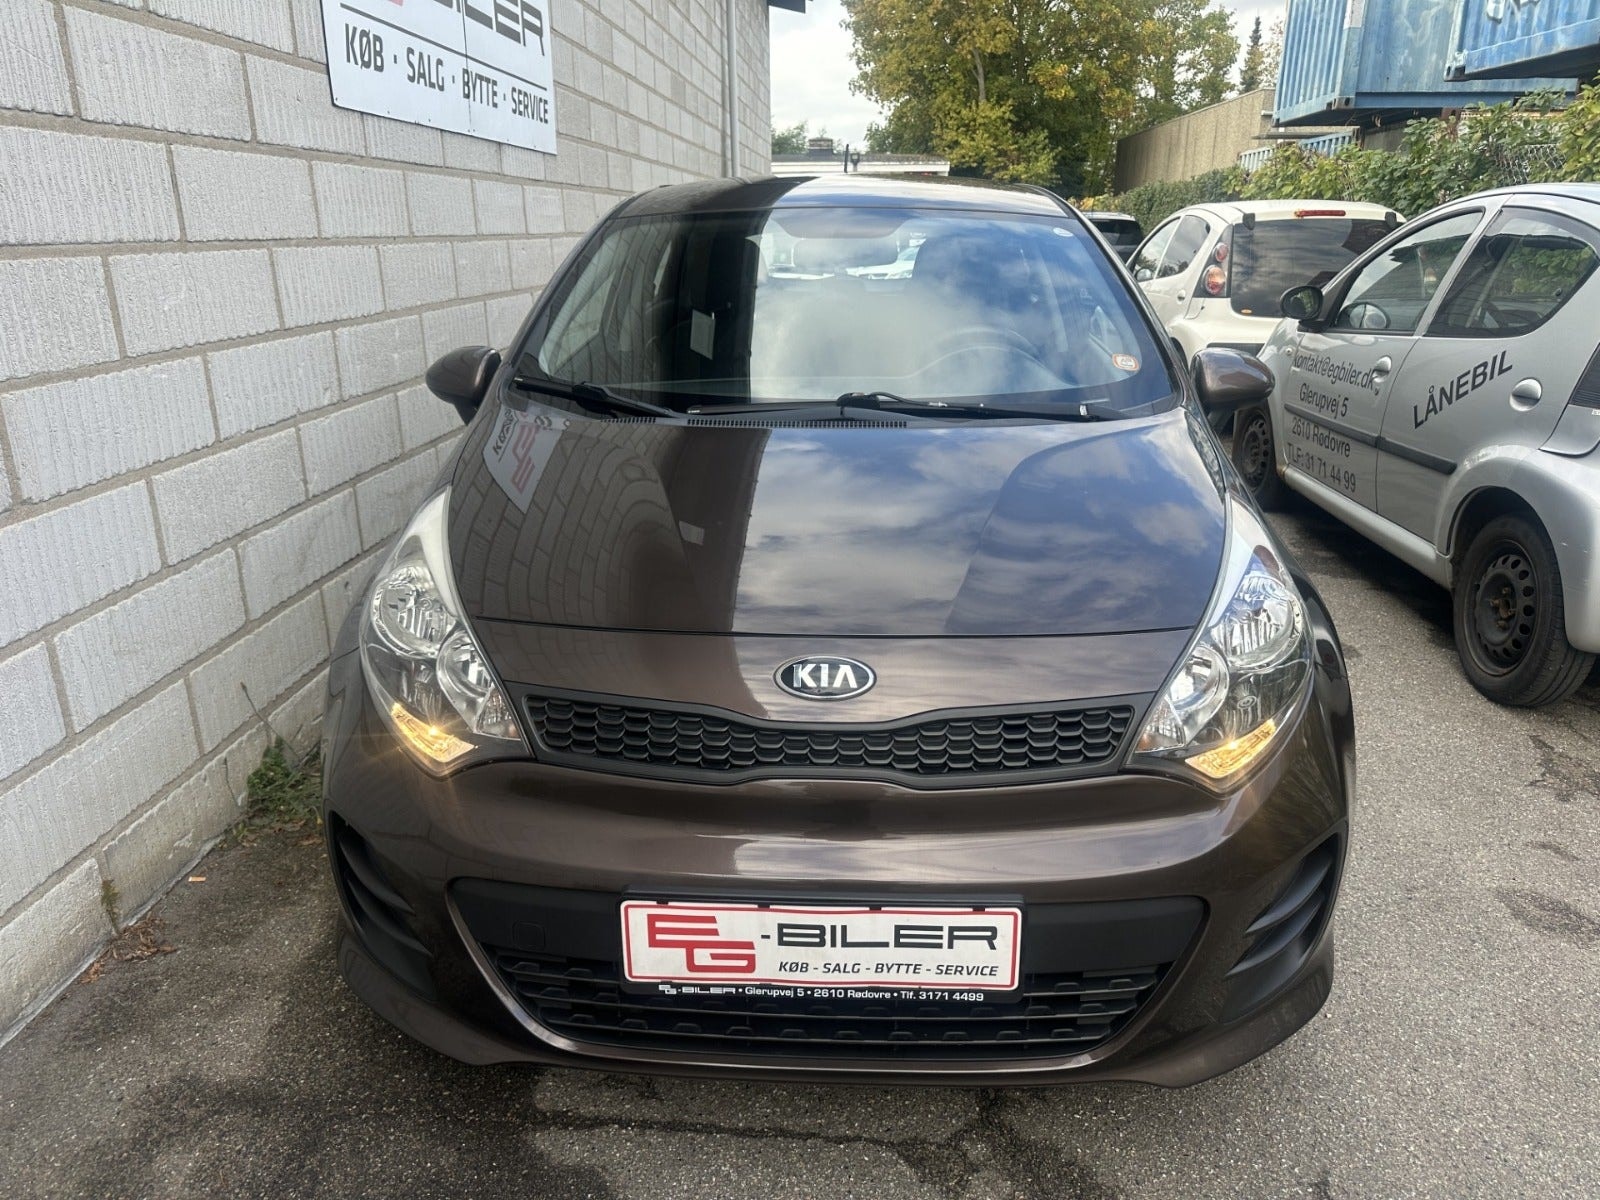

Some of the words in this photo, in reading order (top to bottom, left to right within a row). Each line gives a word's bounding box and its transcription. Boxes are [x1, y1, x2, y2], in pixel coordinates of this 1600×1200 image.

[345, 23, 384, 72] KØB
[406, 47, 444, 91] SALG
[462, 68, 498, 108] BYTTE
[511, 86, 548, 124] SERVICE
[1294, 354, 1375, 390] kontakt@egbiler.dk
[1412, 350, 1513, 429] LÅNEBIL
[1300, 382, 1340, 419] Glerupvej
[1340, 397, 1349, 417] 5
[1292, 417, 1311, 440] 2610
[1305, 452, 1314, 472] 31
[1317, 458, 1327, 478] 71
[1330, 464, 1341, 484] 44
[1343, 471, 1356, 493] 99
[793, 663, 858, 689] KIA
[778, 961, 809, 973] KØB
[822, 962, 861, 974] SALG
[874, 963, 922, 974] BYTTE
[935, 964, 999, 976] SERVICE
[745, 986, 794, 997] Glerupvej
[797, 987, 805, 997] 5
[813, 988, 844, 998] 2610
[918, 991, 949, 1000] 3171
[952, 992, 984, 1001] 4499
